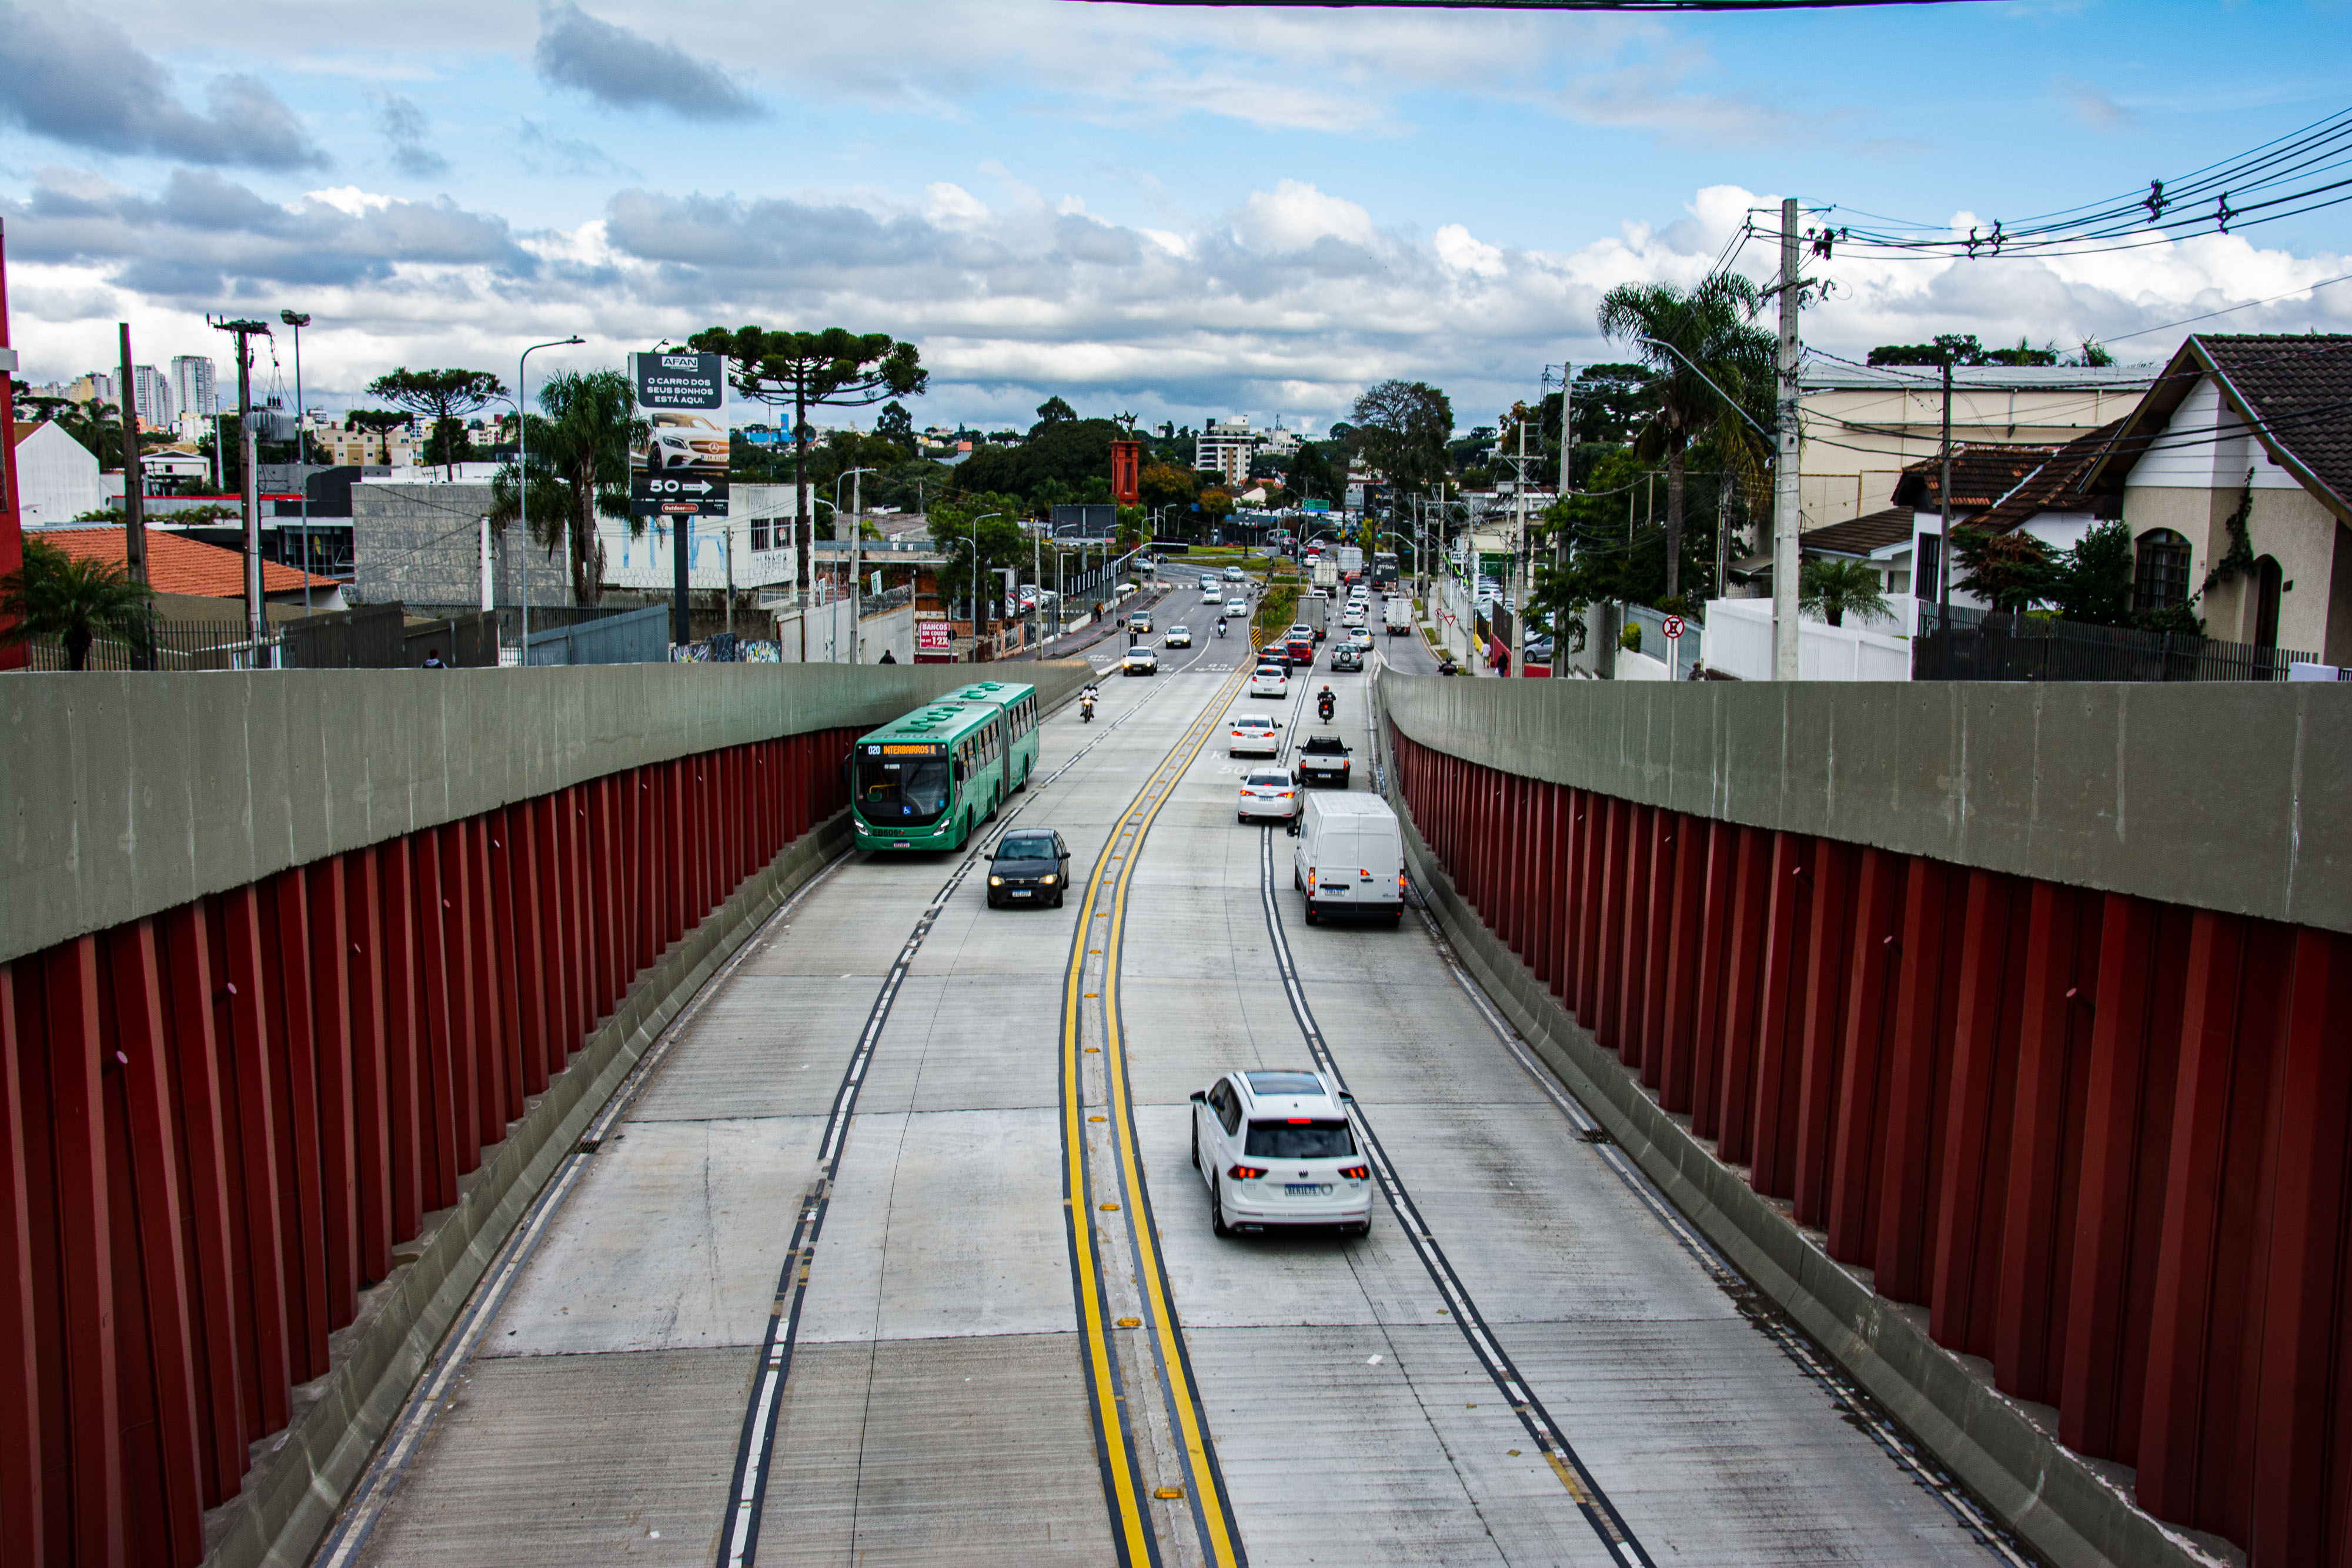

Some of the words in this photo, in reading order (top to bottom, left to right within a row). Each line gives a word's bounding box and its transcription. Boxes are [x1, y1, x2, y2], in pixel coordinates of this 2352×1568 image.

[654, 394, 679, 403] ESTÁ
[650, 479, 680, 493] 50
[932, 637, 948, 645] 12X
[868, 745, 881, 755] 020
[883, 745, 929, 754] INTERBAIRROS
[931, 745, 935, 754] II
[1218, 764, 1247, 774] 50
